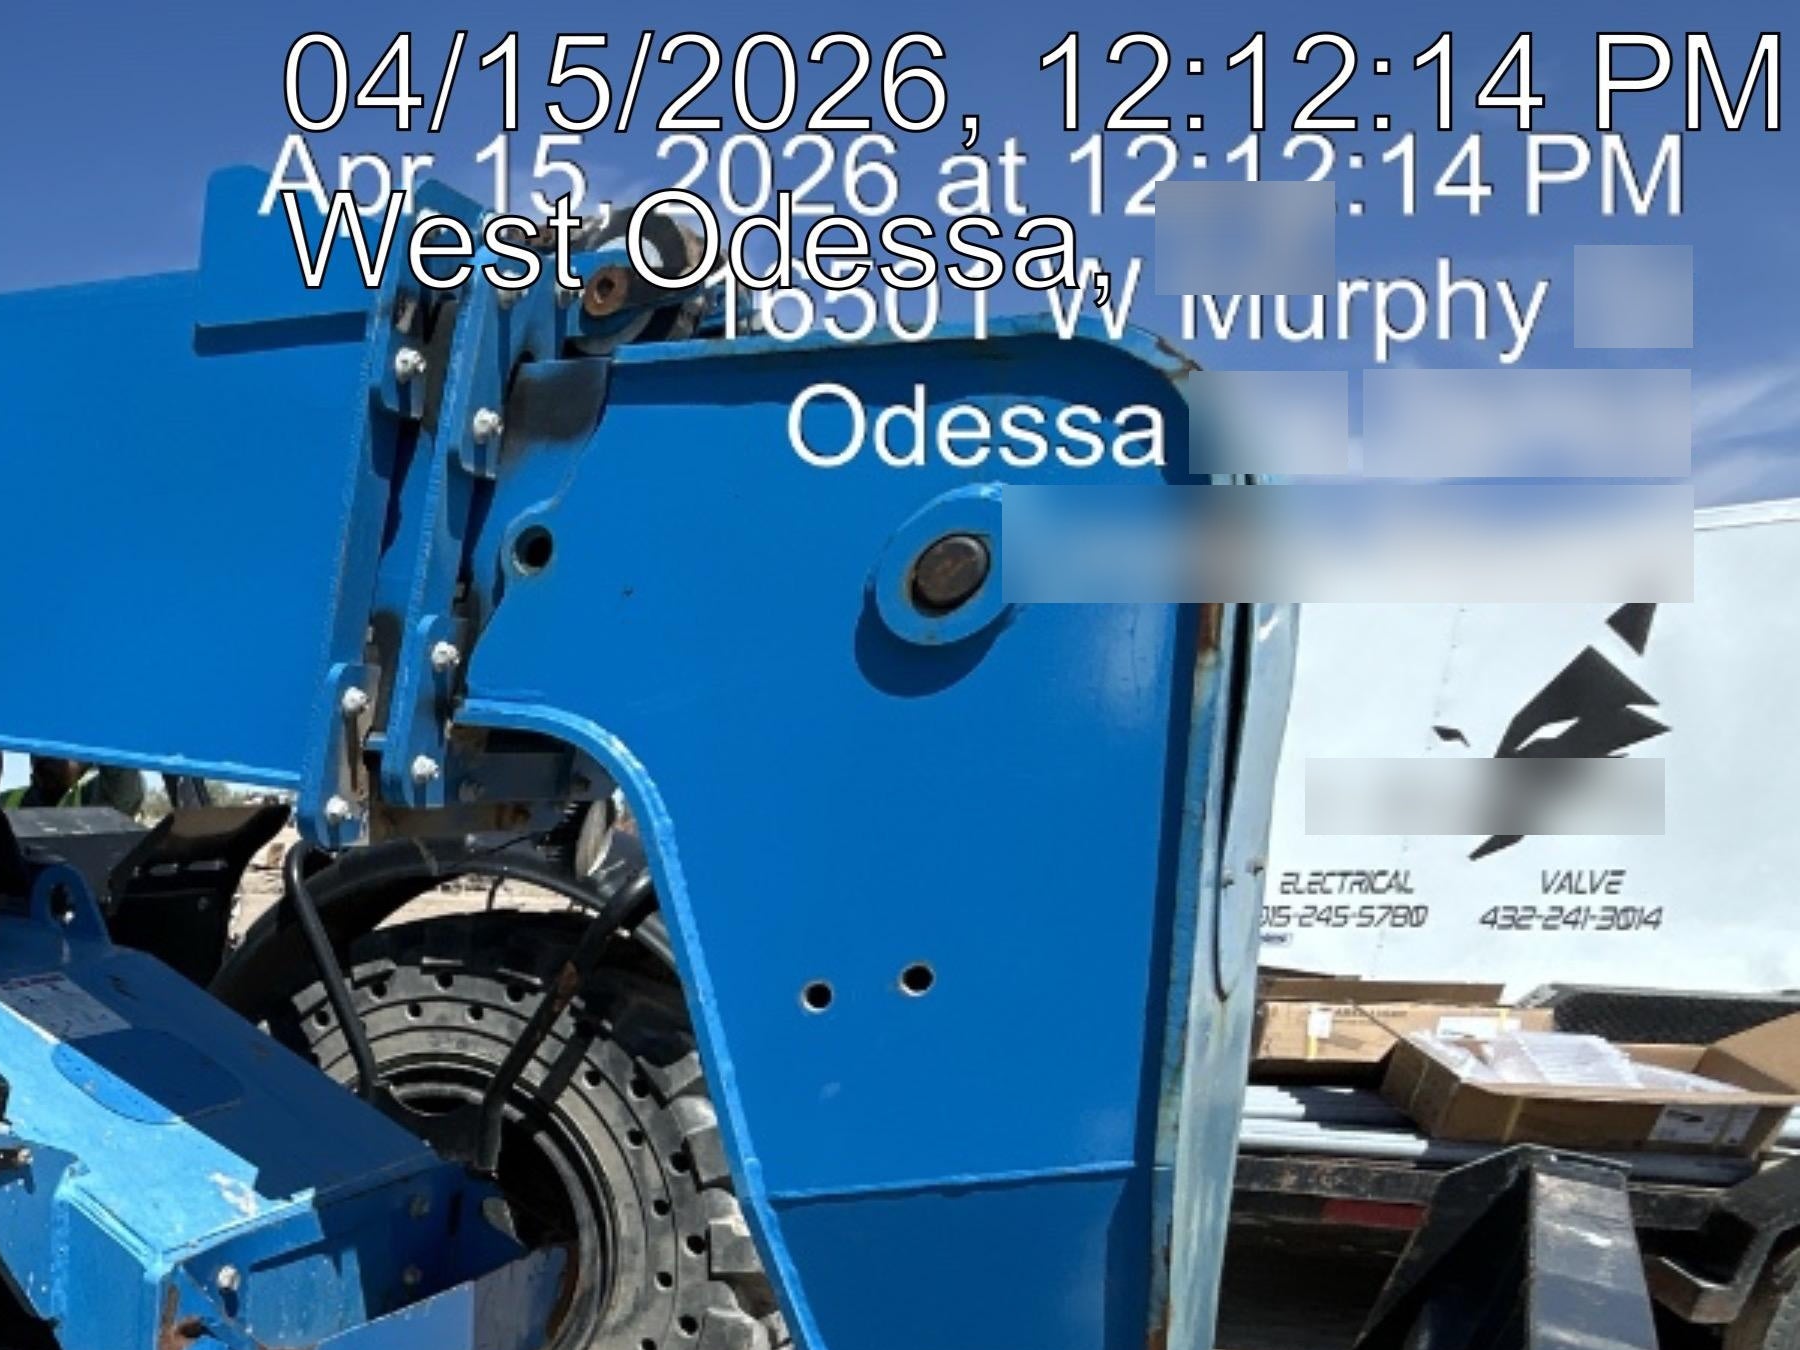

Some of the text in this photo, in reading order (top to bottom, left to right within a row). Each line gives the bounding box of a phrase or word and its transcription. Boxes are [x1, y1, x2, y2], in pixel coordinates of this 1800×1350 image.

[1279, 870, 1415, 895] ELECTRICAL
[1540, 869, 1627, 895] VALVE
[1478, 905, 1665, 931] 432-241-3014
